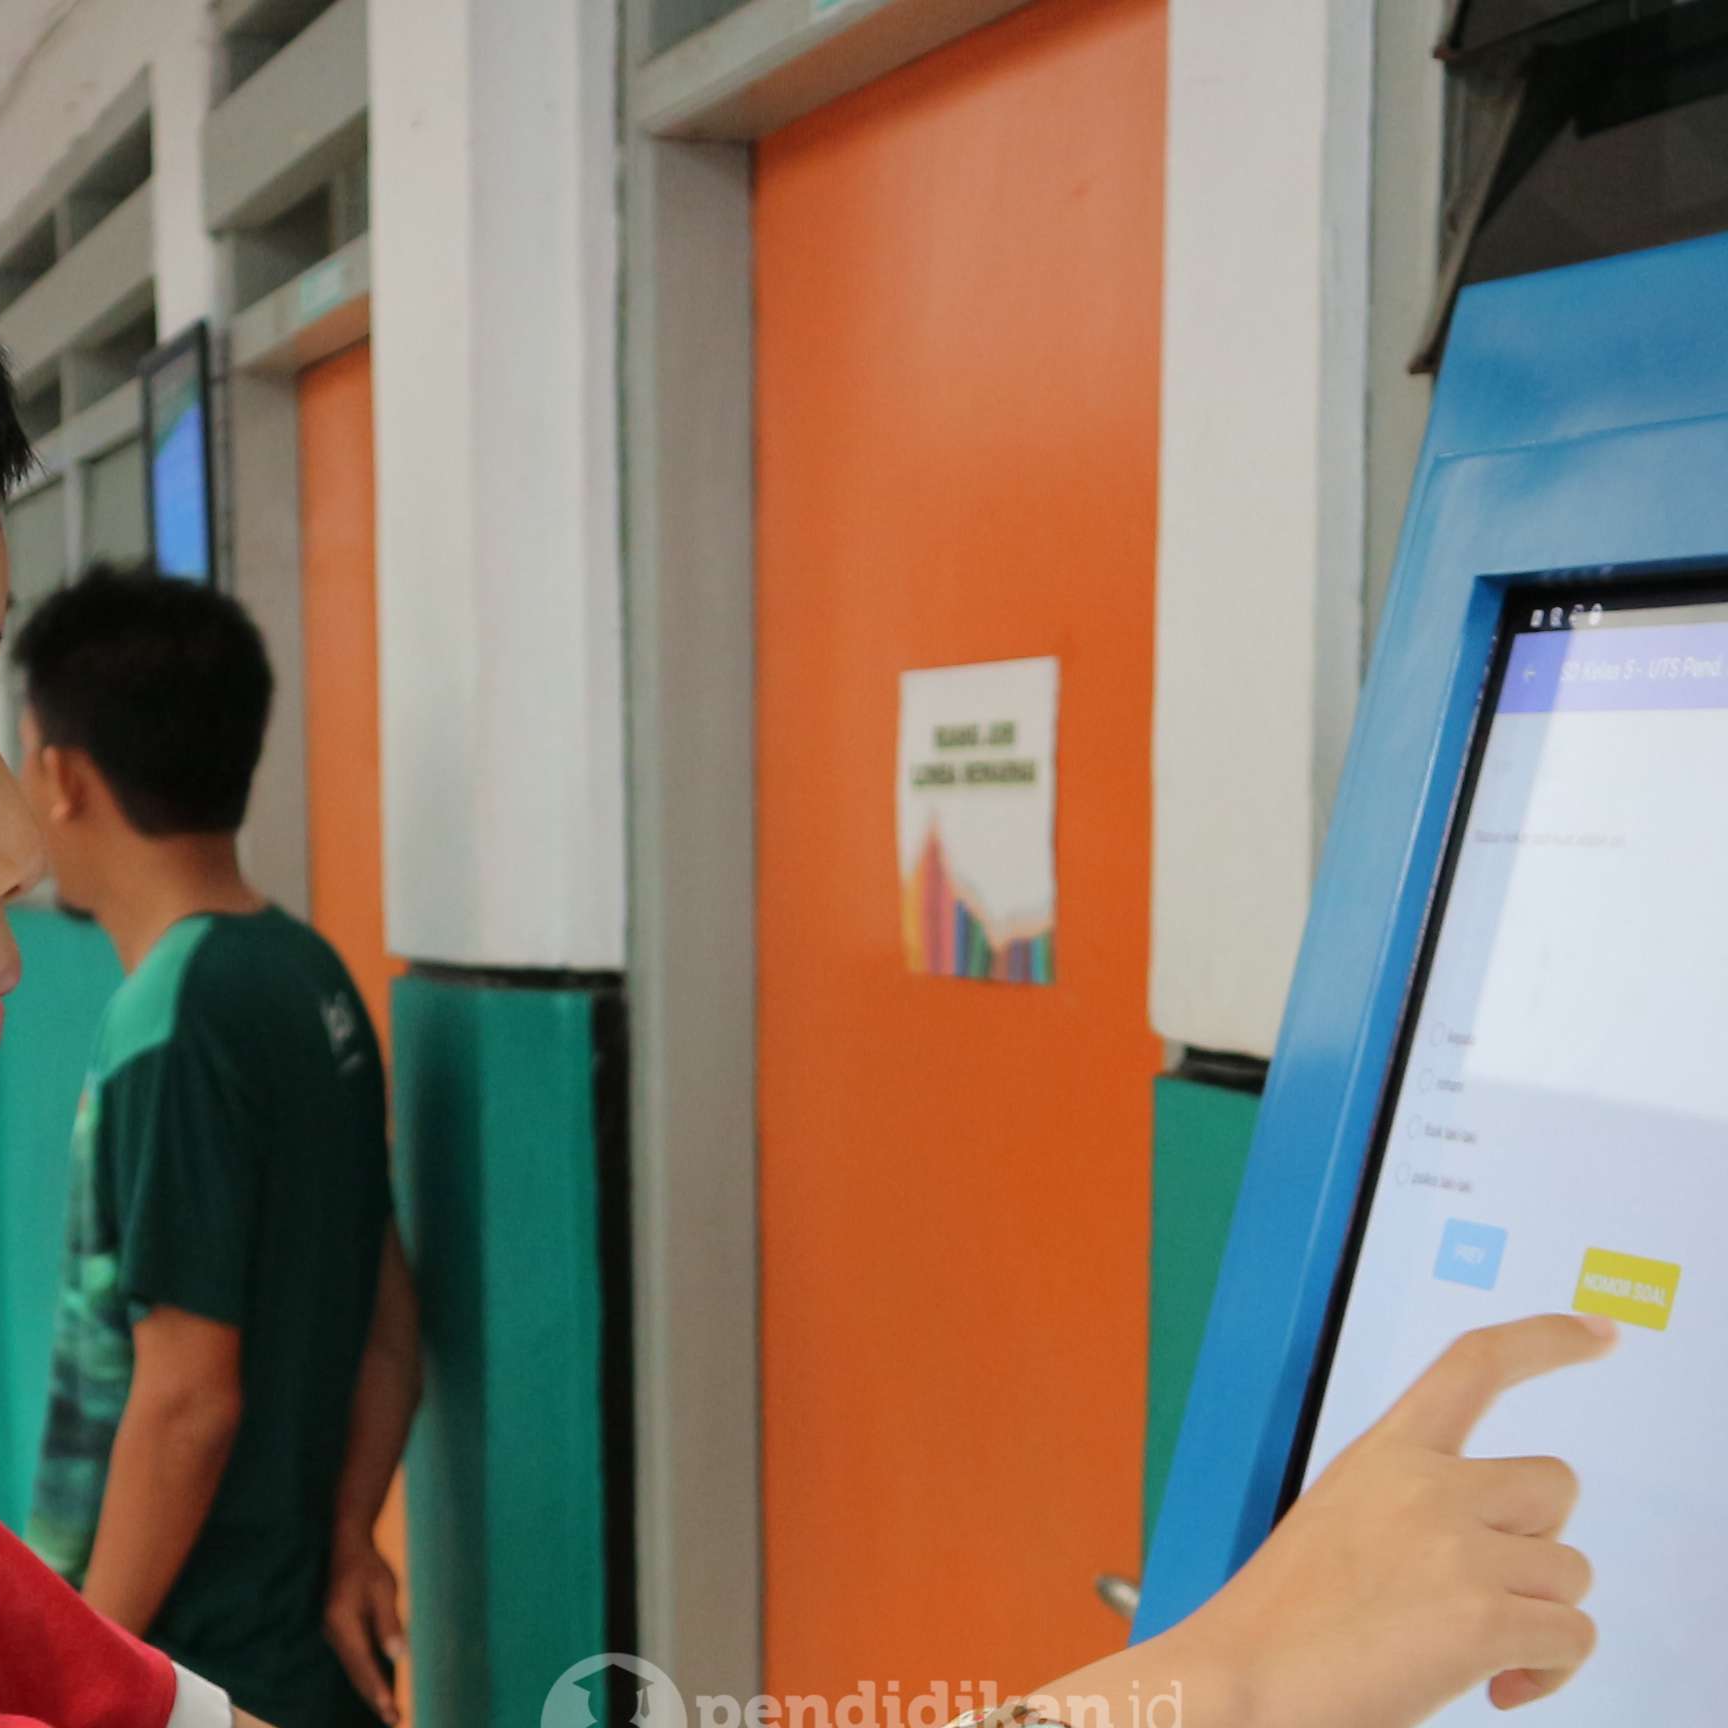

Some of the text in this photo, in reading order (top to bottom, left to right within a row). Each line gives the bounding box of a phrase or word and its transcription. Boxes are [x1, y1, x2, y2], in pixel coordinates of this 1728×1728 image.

[1648, 655, 1680, 680] UTS
[1584, 1272, 1671, 1307] NOMOR SOAL
